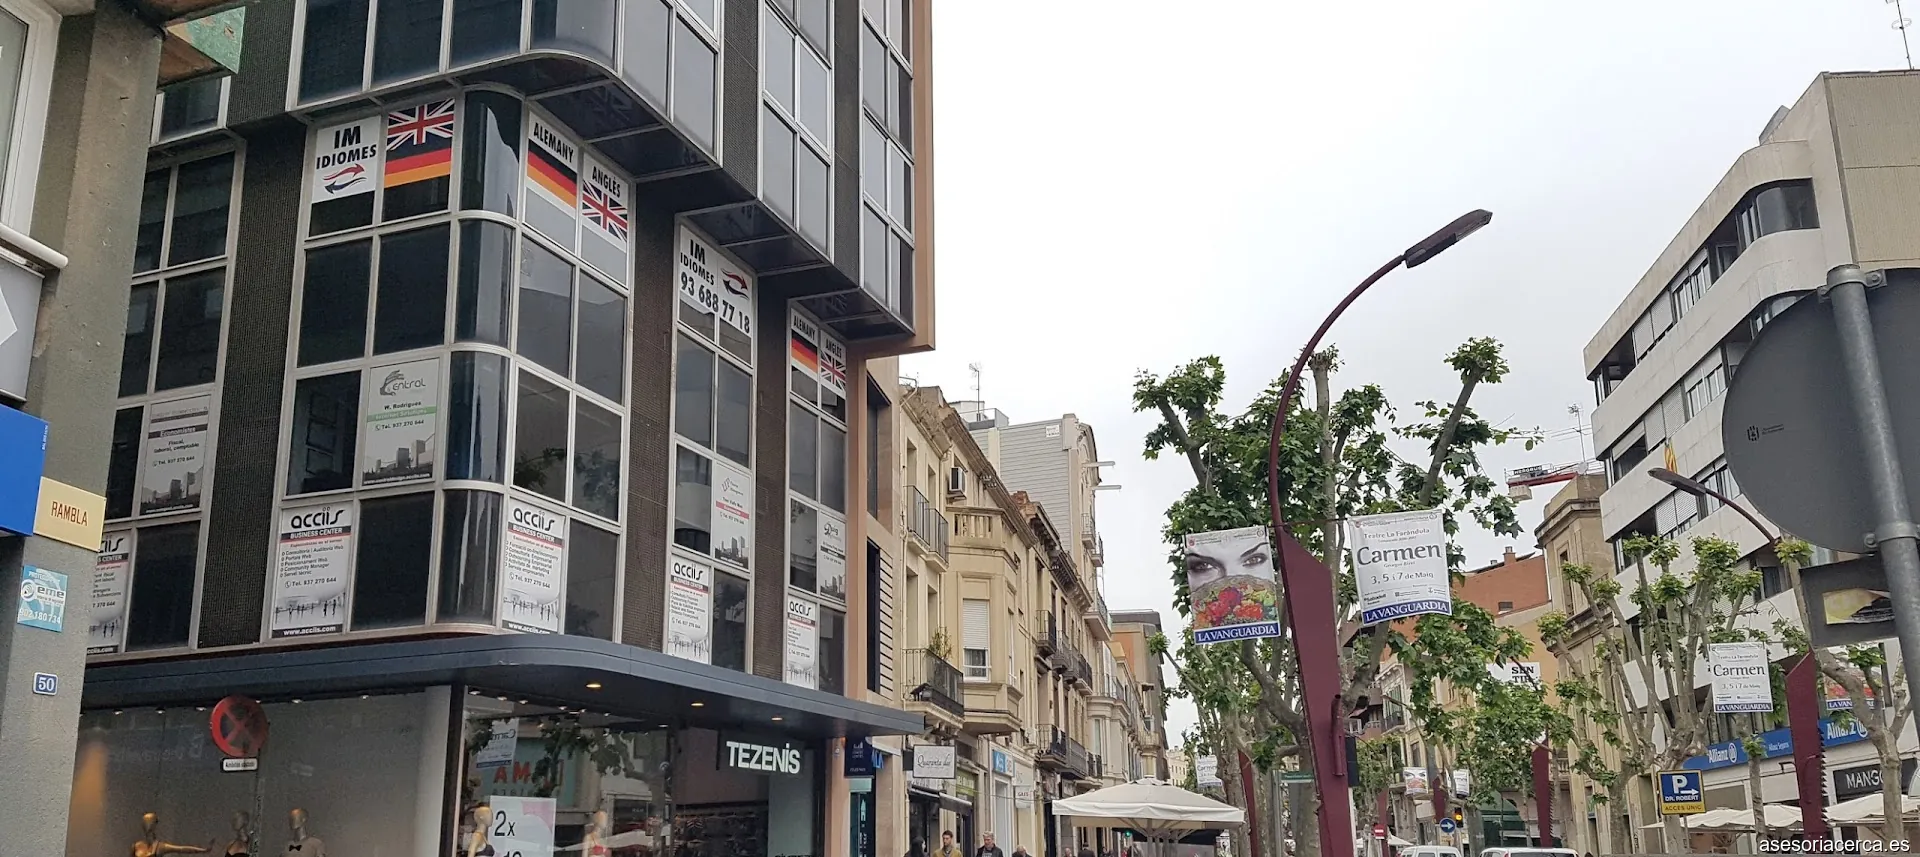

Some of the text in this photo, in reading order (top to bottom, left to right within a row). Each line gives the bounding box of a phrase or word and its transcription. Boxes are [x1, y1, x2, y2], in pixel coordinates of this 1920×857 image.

[334, 125, 361, 149] IM
[532, 122, 574, 164] ALEMANY
[316, 145, 377, 170] IDIOMES
[690, 239, 706, 265] IM
[680, 252, 715, 286] IDIOMES
[680, 272, 750, 334] 93 688 77 18
[793, 315, 816, 341] ALEMANY
[51, 501, 88, 527] RAMBLA
[290, 507, 345, 529] acciis
[513, 507, 555, 532] acciis
[290, 527, 343, 540] BUSINESS CENTER
[513, 524, 555, 543] BUSINESS CENTER
[1364, 532, 1385, 540] Teatre
[102, 554, 123, 562] CENTER
[1356, 544, 1443, 566] Carmen
[310, 563, 330, 571] Manager
[674, 562, 704, 581] acciis
[515, 574, 524, 582] Tel.
[1371, 575, 1381, 585] 3,
[1382, 573, 1389, 582] 5
[1397, 572, 1403, 580] 7
[1415, 571, 1434, 580] Maig
[37, 586, 65, 599] eme
[1366, 601, 1448, 622] LA VANGUARDIA
[283, 625, 336, 636] www.acciis.com
[1198, 624, 1277, 642] LA VANGUARDIA
[1511, 666, 1534, 674] SEN
[1713, 664, 1766, 677] Carmen
[38, 677, 55, 692] 50
[1725, 703, 1770, 711] VANGUARDIA
[1709, 748, 1729, 763] Allianz
[1672, 775, 1688, 794] P
